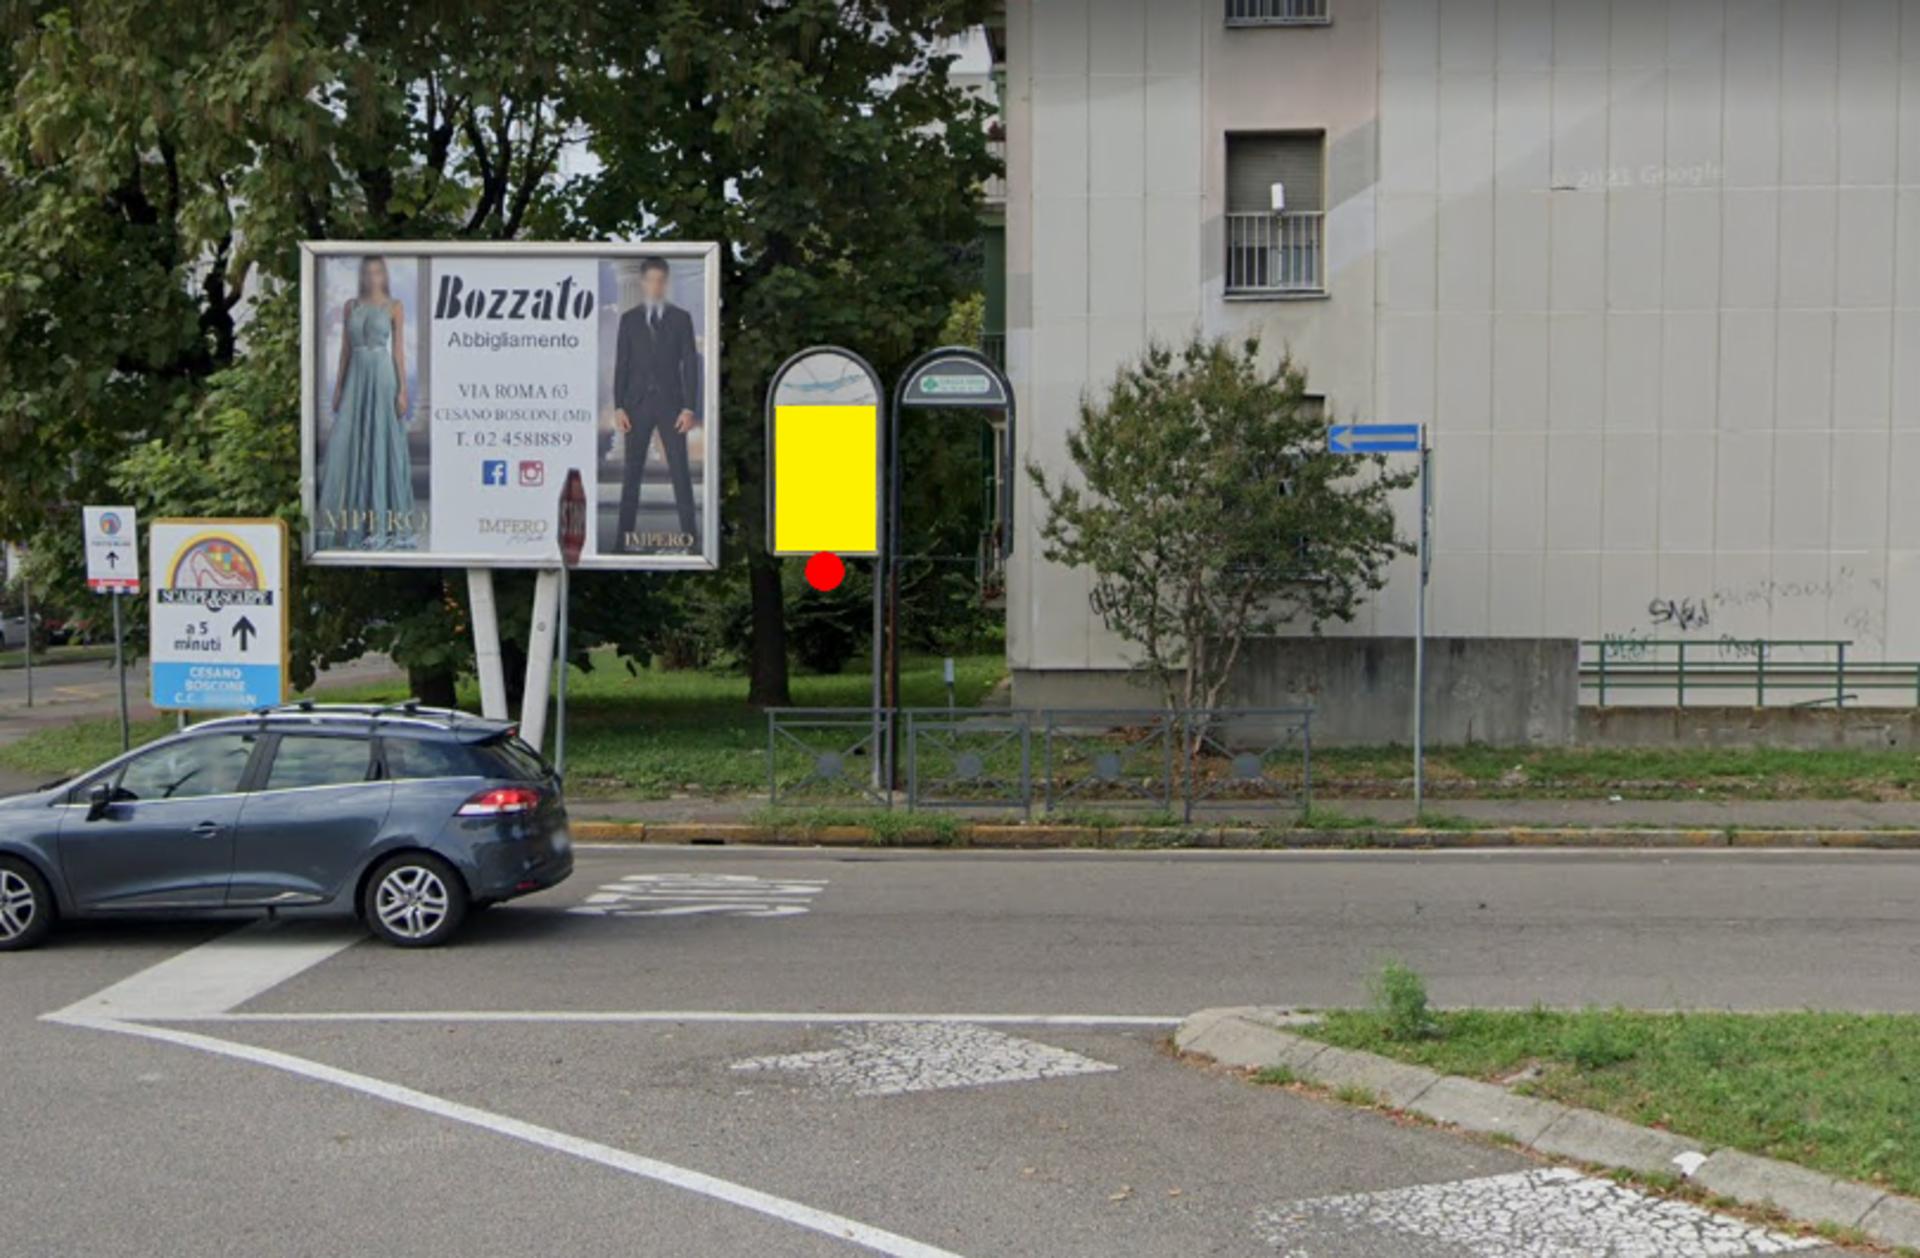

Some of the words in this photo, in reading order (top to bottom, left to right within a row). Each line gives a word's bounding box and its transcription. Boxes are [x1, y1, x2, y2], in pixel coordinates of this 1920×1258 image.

[434, 274, 594, 320] Bozzato
[448, 331, 579, 350] Abbigliamento
[458, 383, 490, 399] VIA
[495, 383, 547, 399] ROMA
[551, 383, 568, 399] 63
[434, 408, 492, 421] CESANO
[495, 408, 557, 421] BOSCONE
[455, 431, 469, 446] T.
[474, 431, 497, 447] 02
[478, 518, 549, 534] IMPERO
[624, 531, 695, 547] IMPERO
[199, 621, 208, 635] 5
[174, 638, 221, 652] minuti
[190, 667, 242, 680] CESANO
